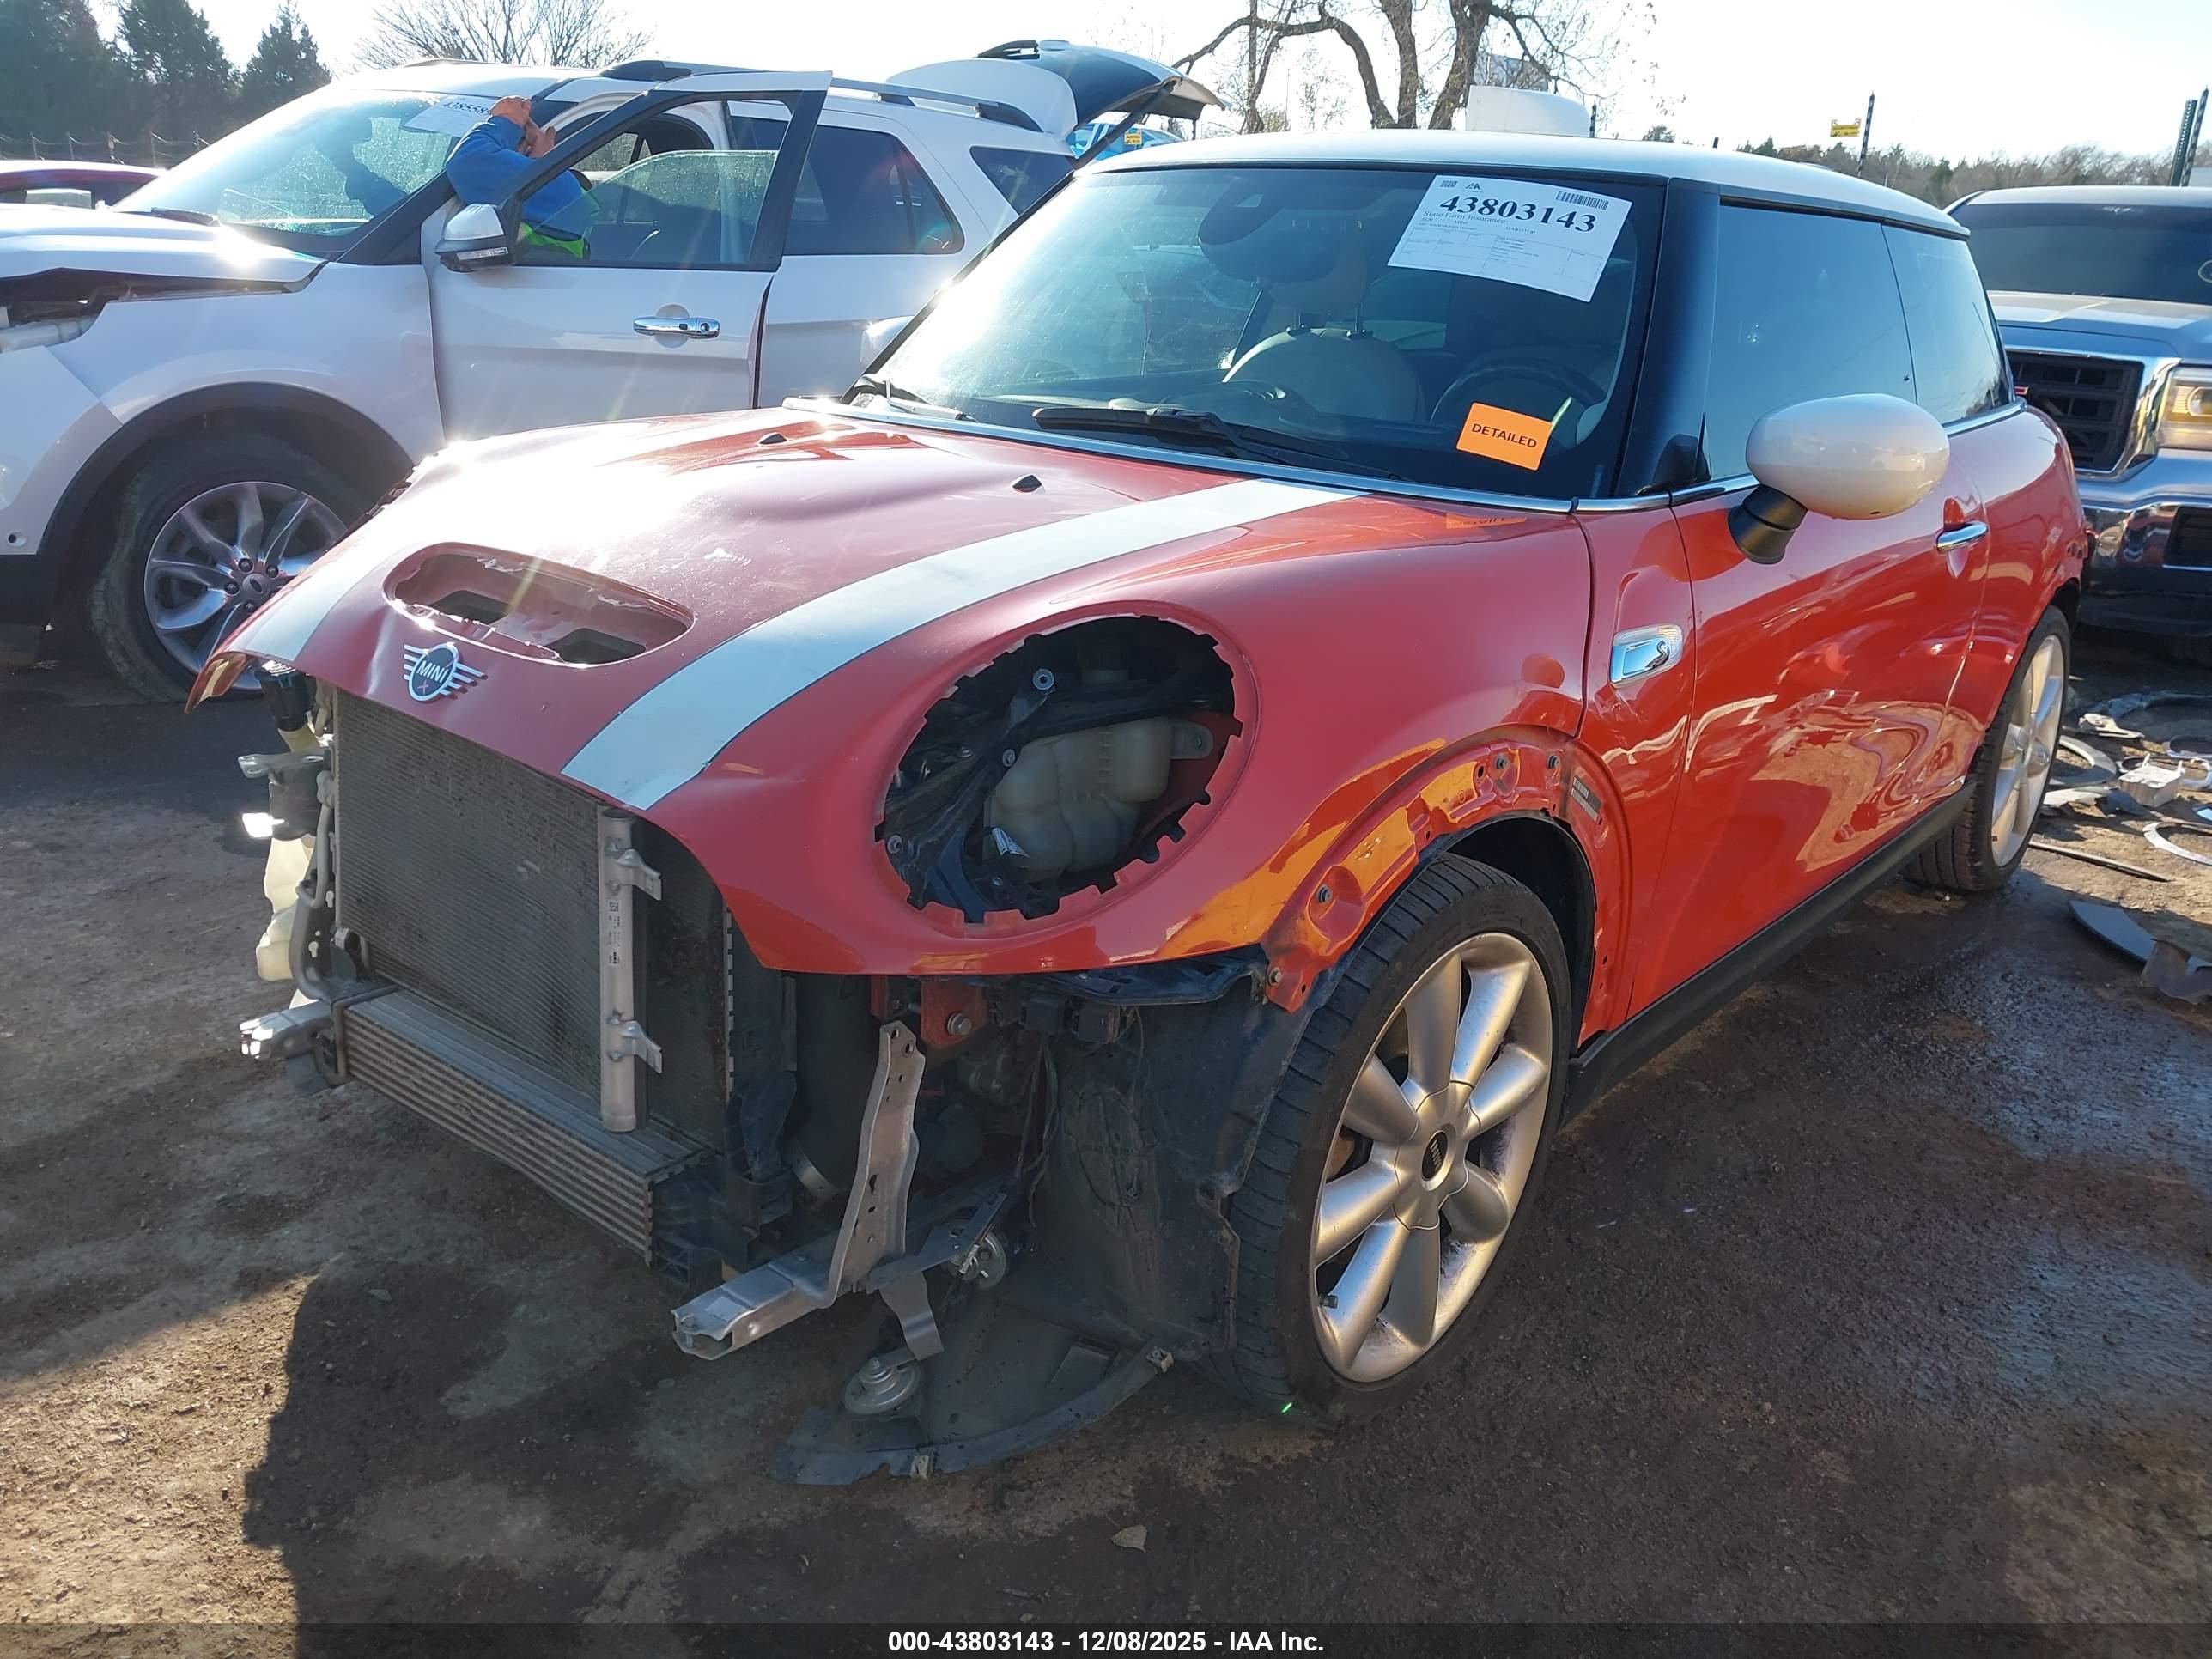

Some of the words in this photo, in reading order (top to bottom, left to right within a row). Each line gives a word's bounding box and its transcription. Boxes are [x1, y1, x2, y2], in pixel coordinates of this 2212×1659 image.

[1439, 195, 1596, 232] 43803143
[1468, 215, 1506, 224] Insurance
[1471, 423, 1538, 448] DETAILED
[416, 660, 448, 684] MINI
